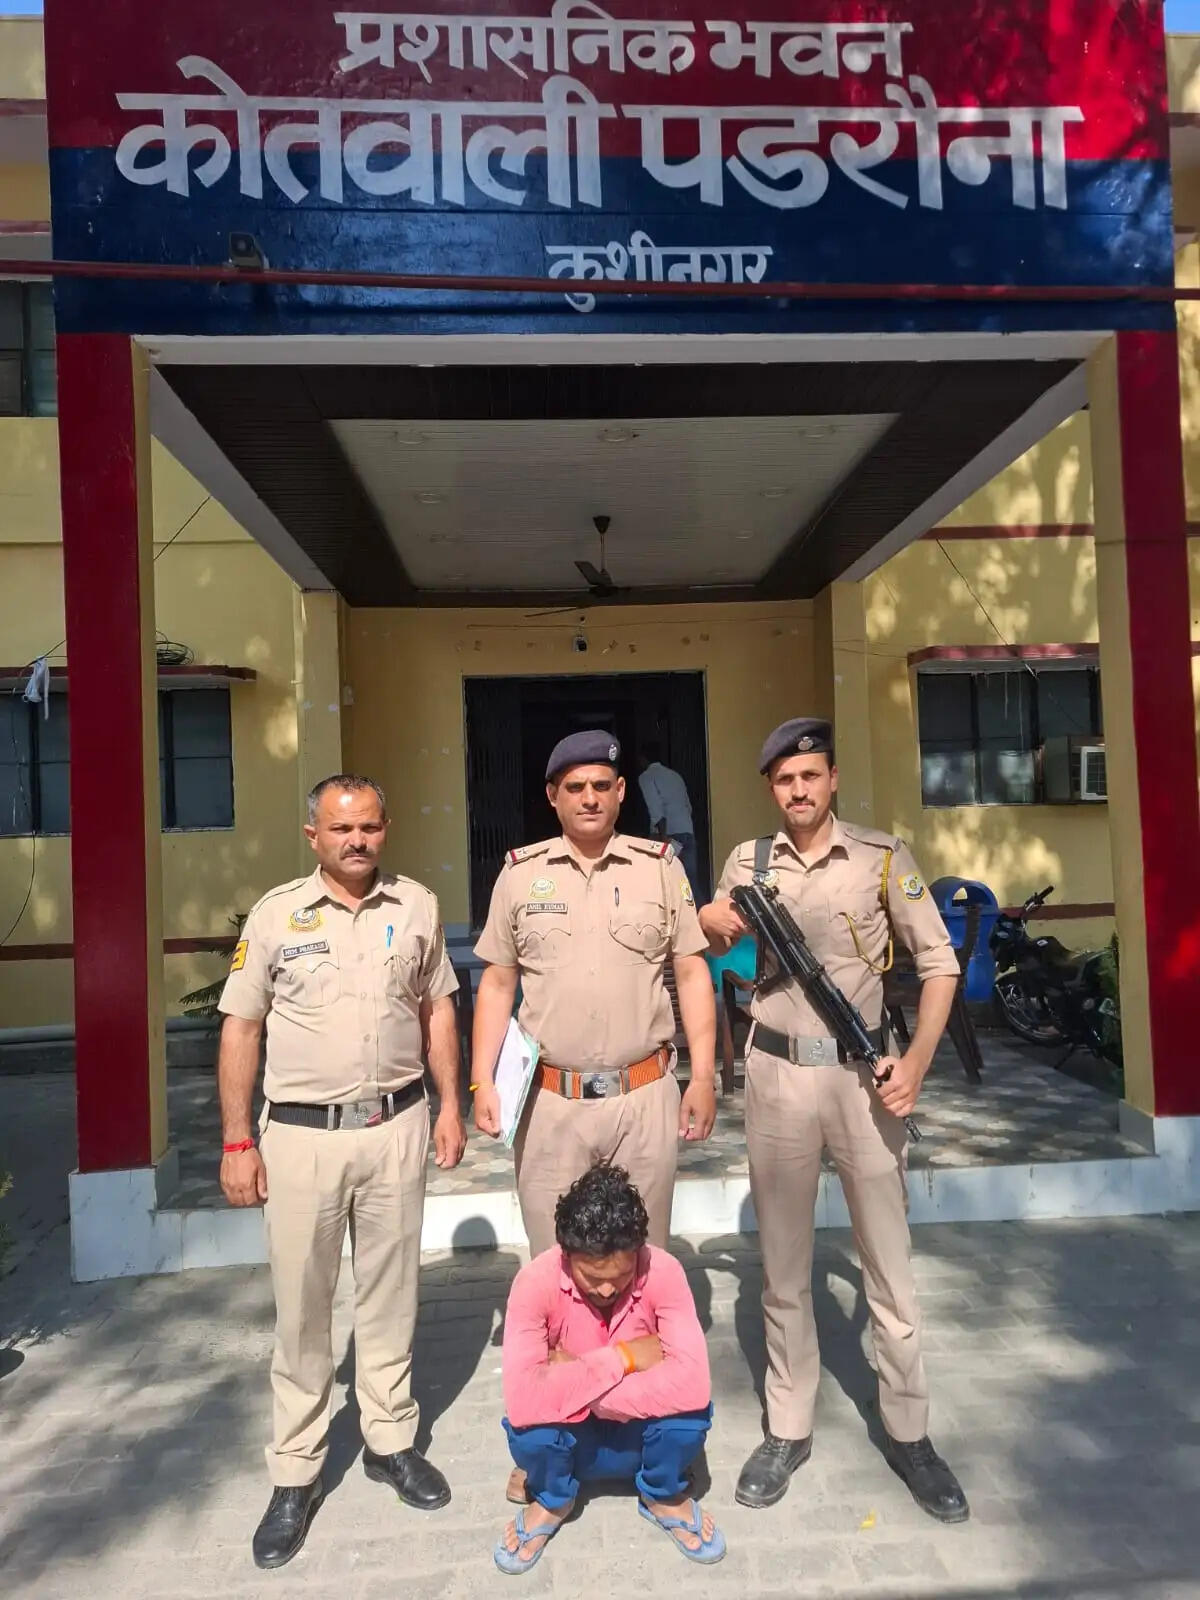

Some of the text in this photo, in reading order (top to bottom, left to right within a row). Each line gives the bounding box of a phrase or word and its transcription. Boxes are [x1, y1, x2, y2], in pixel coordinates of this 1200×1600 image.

[334, 0, 914, 84] प्रशासनिक भवन
[115, 55, 1085, 210] कोतवाली पडरौना
